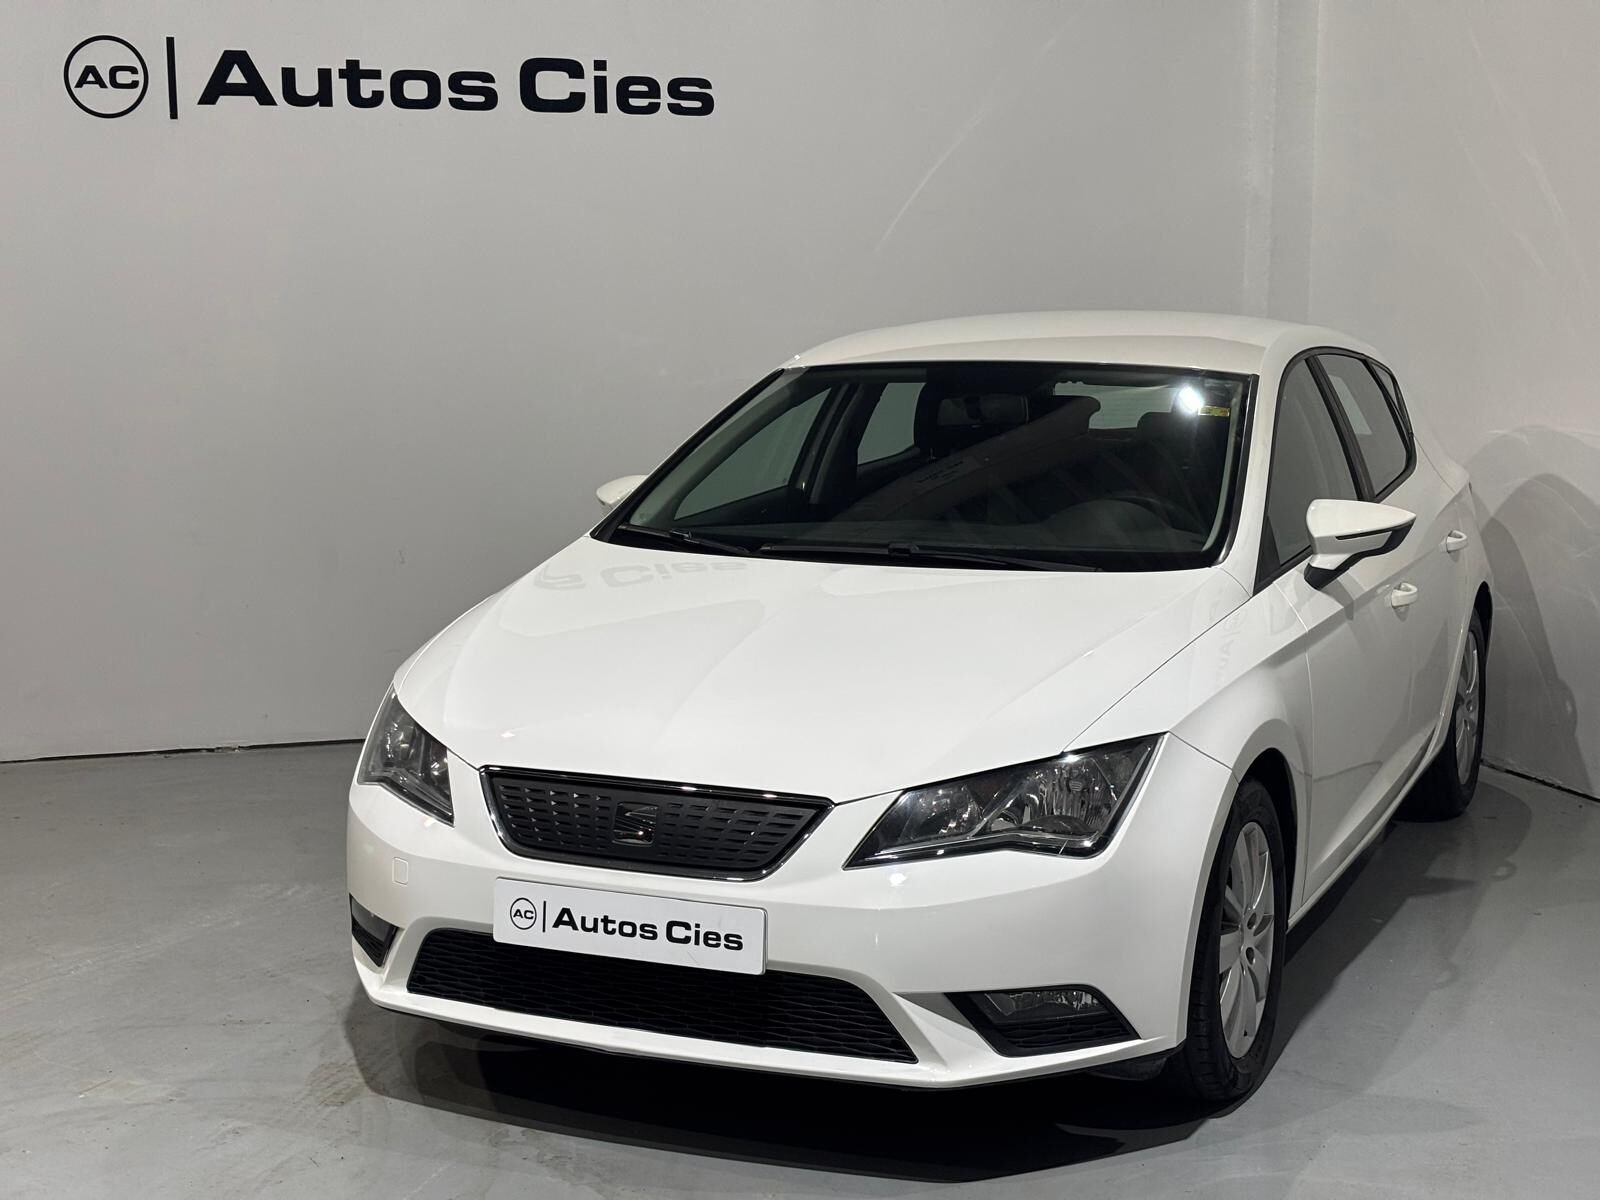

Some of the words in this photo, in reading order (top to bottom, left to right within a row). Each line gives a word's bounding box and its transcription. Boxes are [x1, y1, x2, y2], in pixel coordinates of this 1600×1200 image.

[74, 64, 141, 90] AC
[197, 49, 499, 112] Autos
[519, 57, 715, 117] Cies
[512, 908, 535, 921] AC
[552, 907, 659, 941] Autos
[665, 920, 744, 951] Cies
